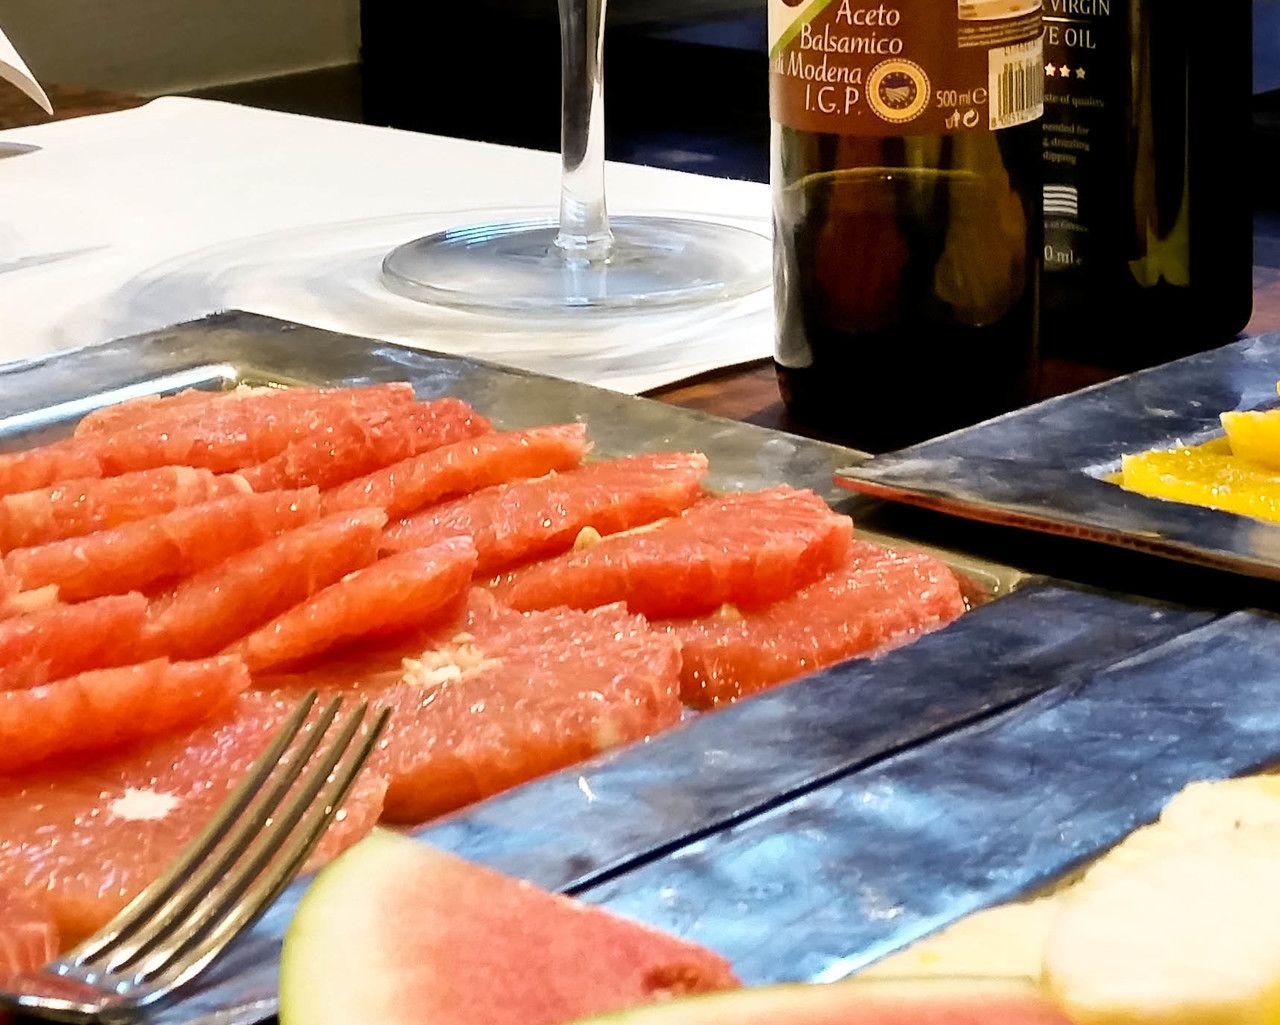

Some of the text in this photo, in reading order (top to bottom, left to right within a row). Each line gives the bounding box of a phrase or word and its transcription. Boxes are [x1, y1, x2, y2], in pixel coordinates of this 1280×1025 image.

[800, 22, 904, 55] Balsamico
[1064, 27, 1097, 50] OIL
[787, 50, 862, 85] Modena
[805, 83, 862, 116] I.G.P.
[936, 89, 958, 108] 500
[959, 90, 972, 106] ml
[1056, 249, 1074, 264] ml
